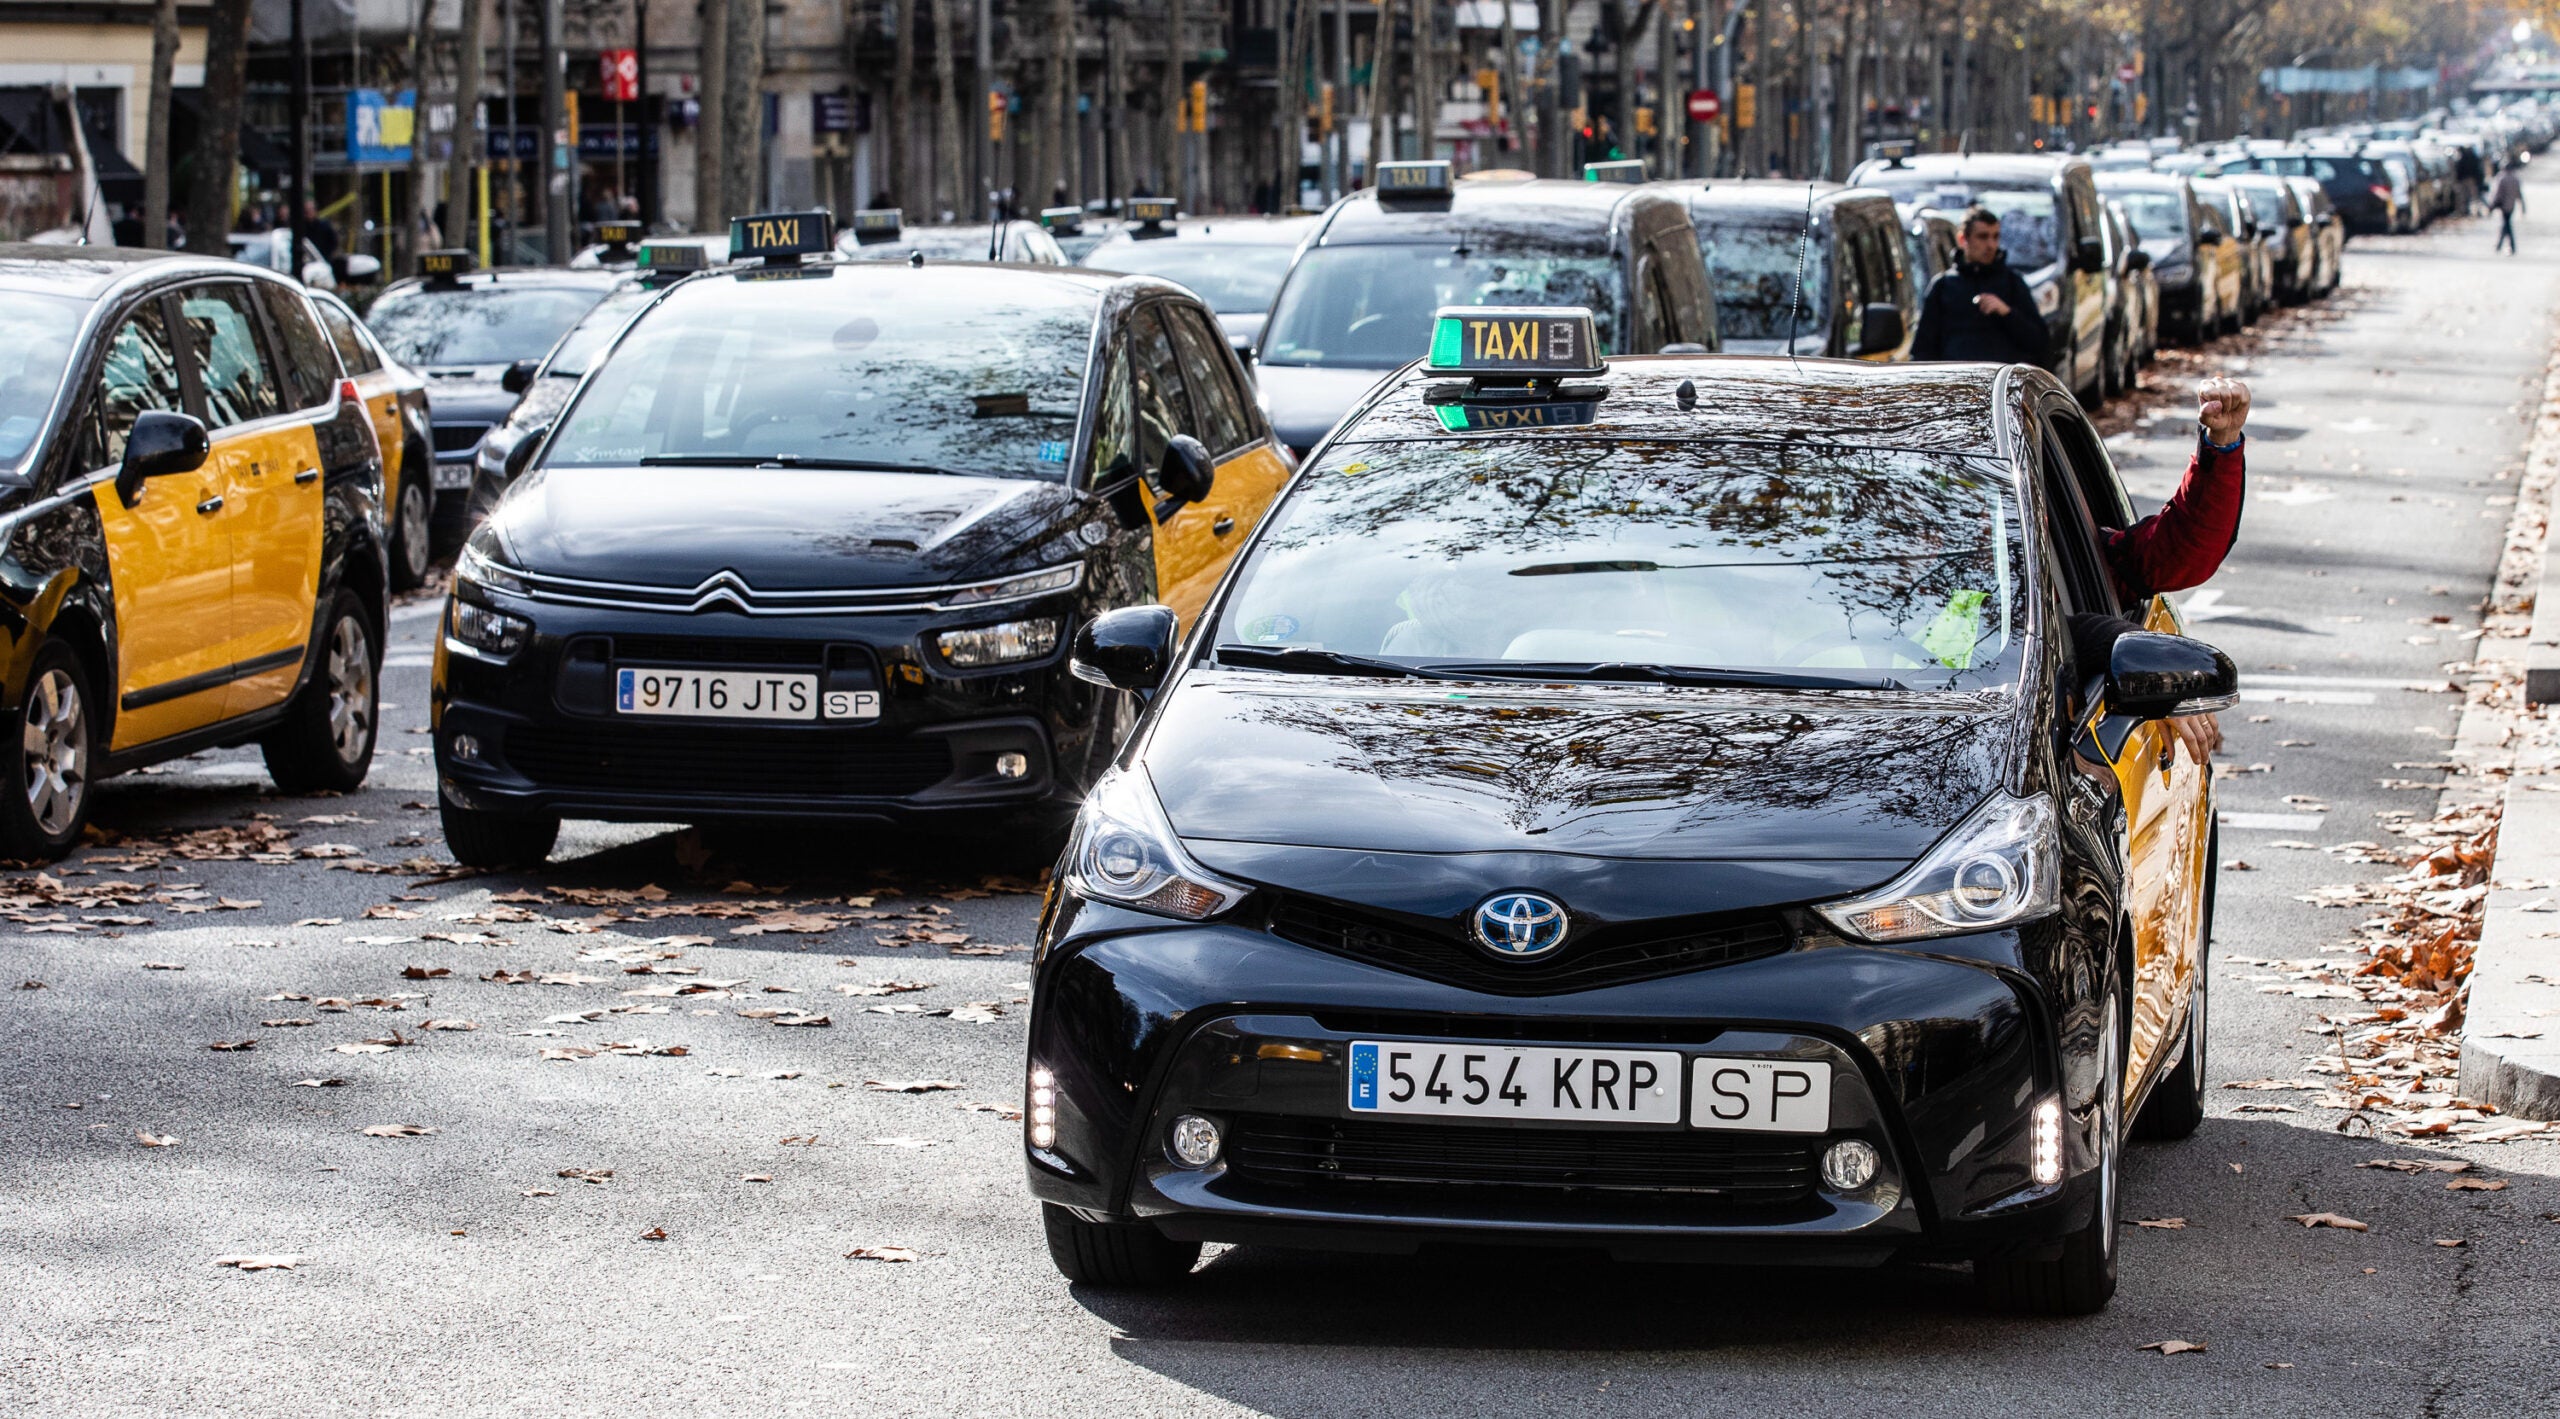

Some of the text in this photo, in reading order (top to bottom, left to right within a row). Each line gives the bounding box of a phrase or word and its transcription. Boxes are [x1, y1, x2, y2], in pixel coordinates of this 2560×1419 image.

[1390, 168, 1426, 187] TAXI
[747, 219, 799, 248] TAXI
[1469, 321, 1539, 360] TAXI
[642, 676, 807, 712] 9716 JTS
[829, 694, 874, 715] SP
[1359, 1083, 1370, 1098] E
[1388, 1052, 1658, 1111] 5454 KRP
[1710, 1068, 1812, 1123] SP
